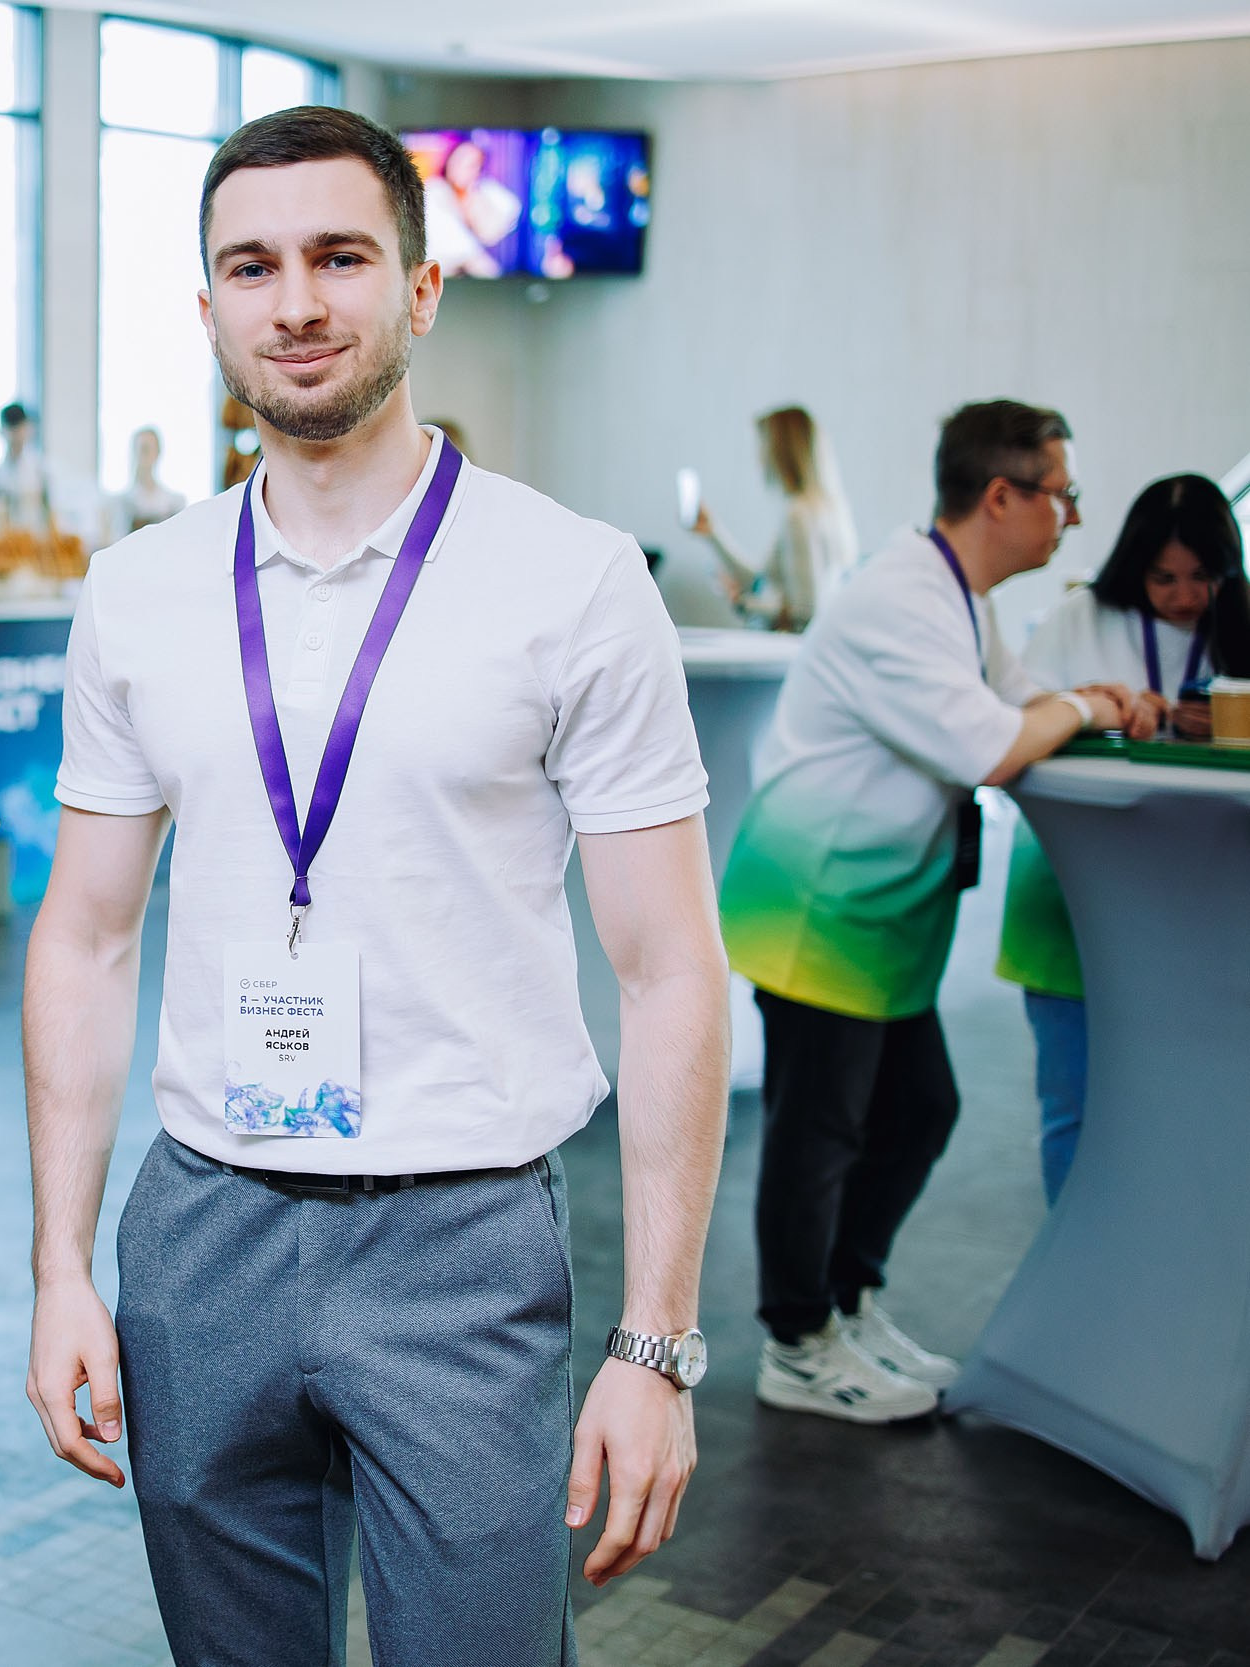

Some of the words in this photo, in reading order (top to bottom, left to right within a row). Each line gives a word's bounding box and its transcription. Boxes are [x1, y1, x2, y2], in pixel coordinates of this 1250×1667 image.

[252, 981, 278, 989] СБЕР
[240, 995, 247, 1004] Я
[263, 995, 324, 1006] УЧАСТНИК
[240, 1006, 285, 1016] БИЗНЕС
[287, 1007, 324, 1017] ФЕСТА
[264, 1028, 310, 1039] АНДРЕЙ
[265, 1041, 310, 1051] ЯСЬКОВ
[278, 1054, 296, 1062] SRV
